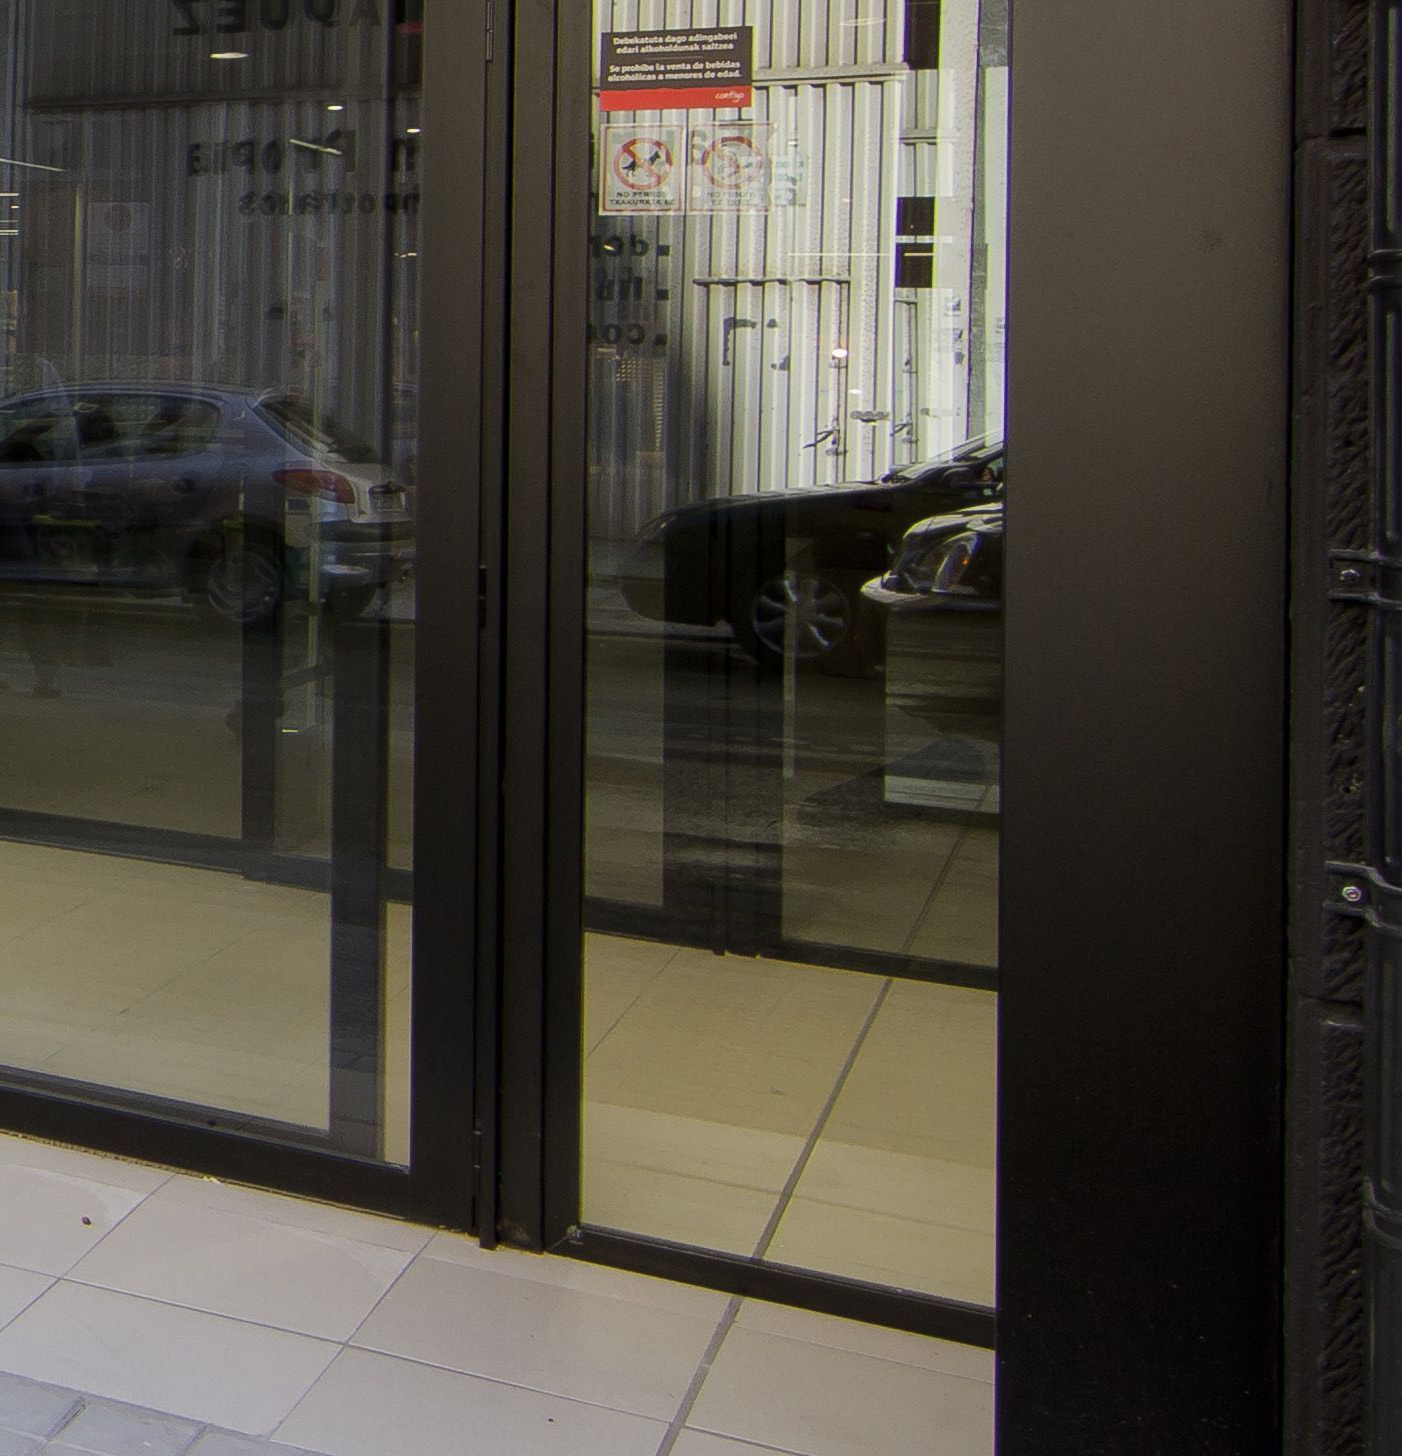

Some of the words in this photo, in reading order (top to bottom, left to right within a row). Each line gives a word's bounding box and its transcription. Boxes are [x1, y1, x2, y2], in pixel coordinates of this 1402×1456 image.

[612, 36, 663, 45] Debekatuta
[664, 34, 686, 44] dago
[616, 46, 639, 54] edari
[702, 43, 734, 51] saltzea
[609, 64, 620, 73] Se
[656, 62, 665, 71] la
[666, 62, 691, 70] venta
[692, 61, 704, 69] de
[705, 60, 741, 69] bebidas
[665, 72, 703, 80] menores
[704, 70, 715, 79] de
[717, 69, 743, 78] edad.
